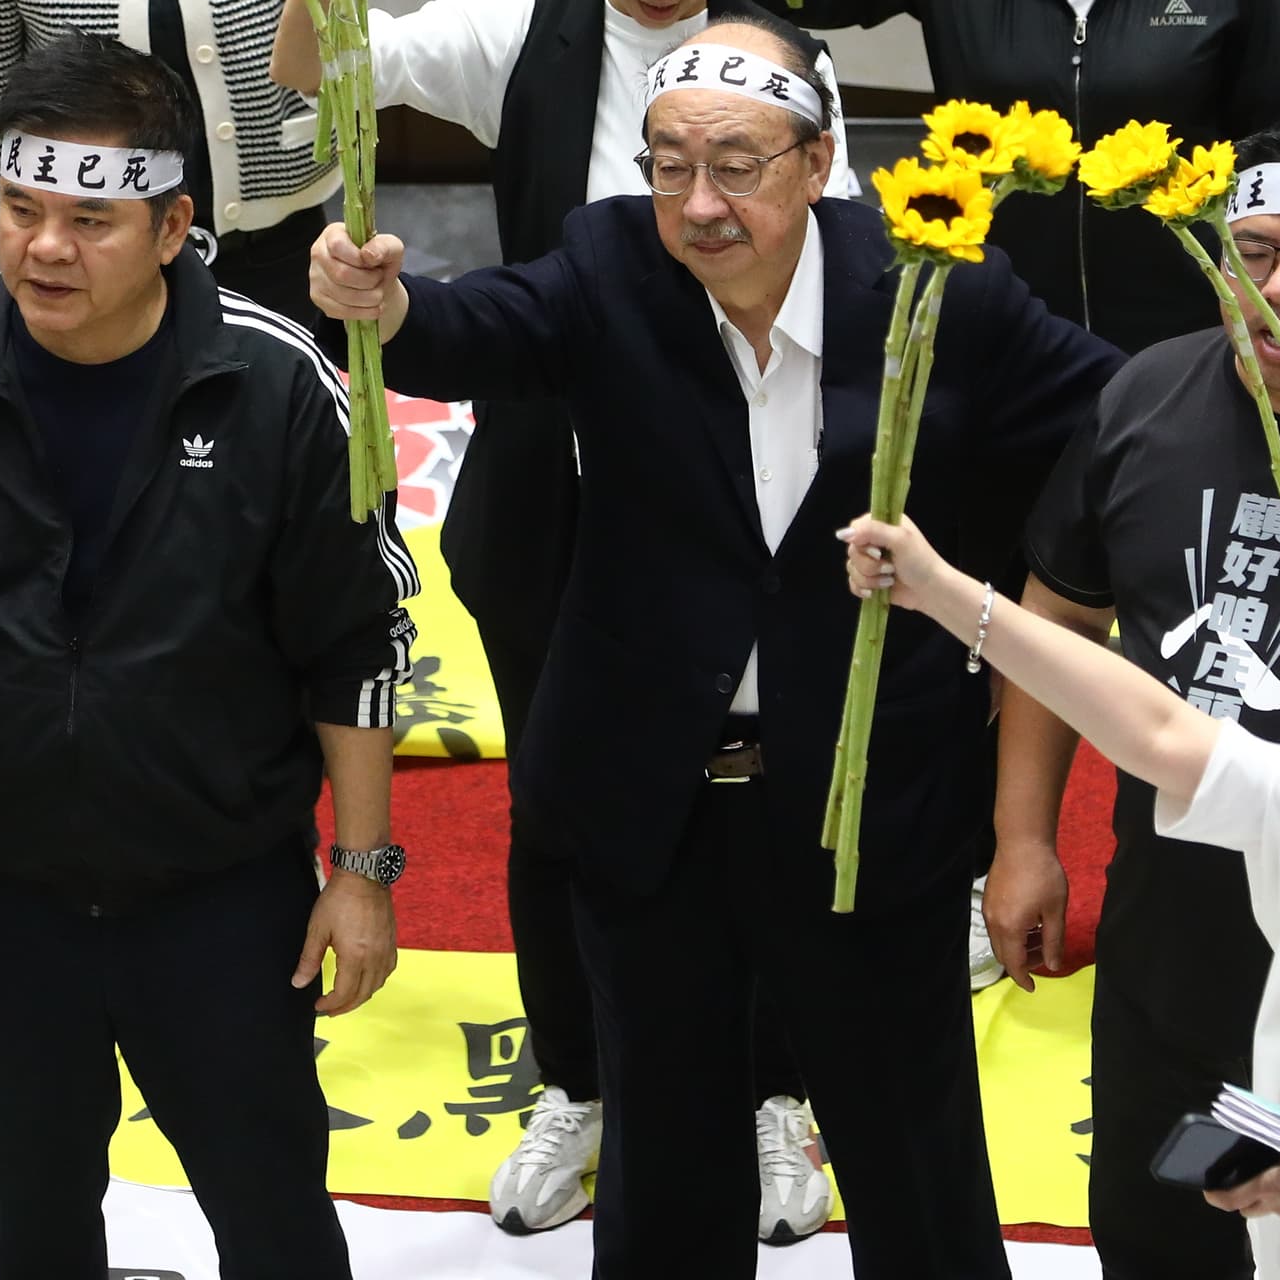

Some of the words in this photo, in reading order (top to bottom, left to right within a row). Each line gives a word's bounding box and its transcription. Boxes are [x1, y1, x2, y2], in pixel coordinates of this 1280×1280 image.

[653, 50, 791, 101] 民主已死
[5, 135, 151, 193] 民主已死
[180, 458, 214, 469] adidas
